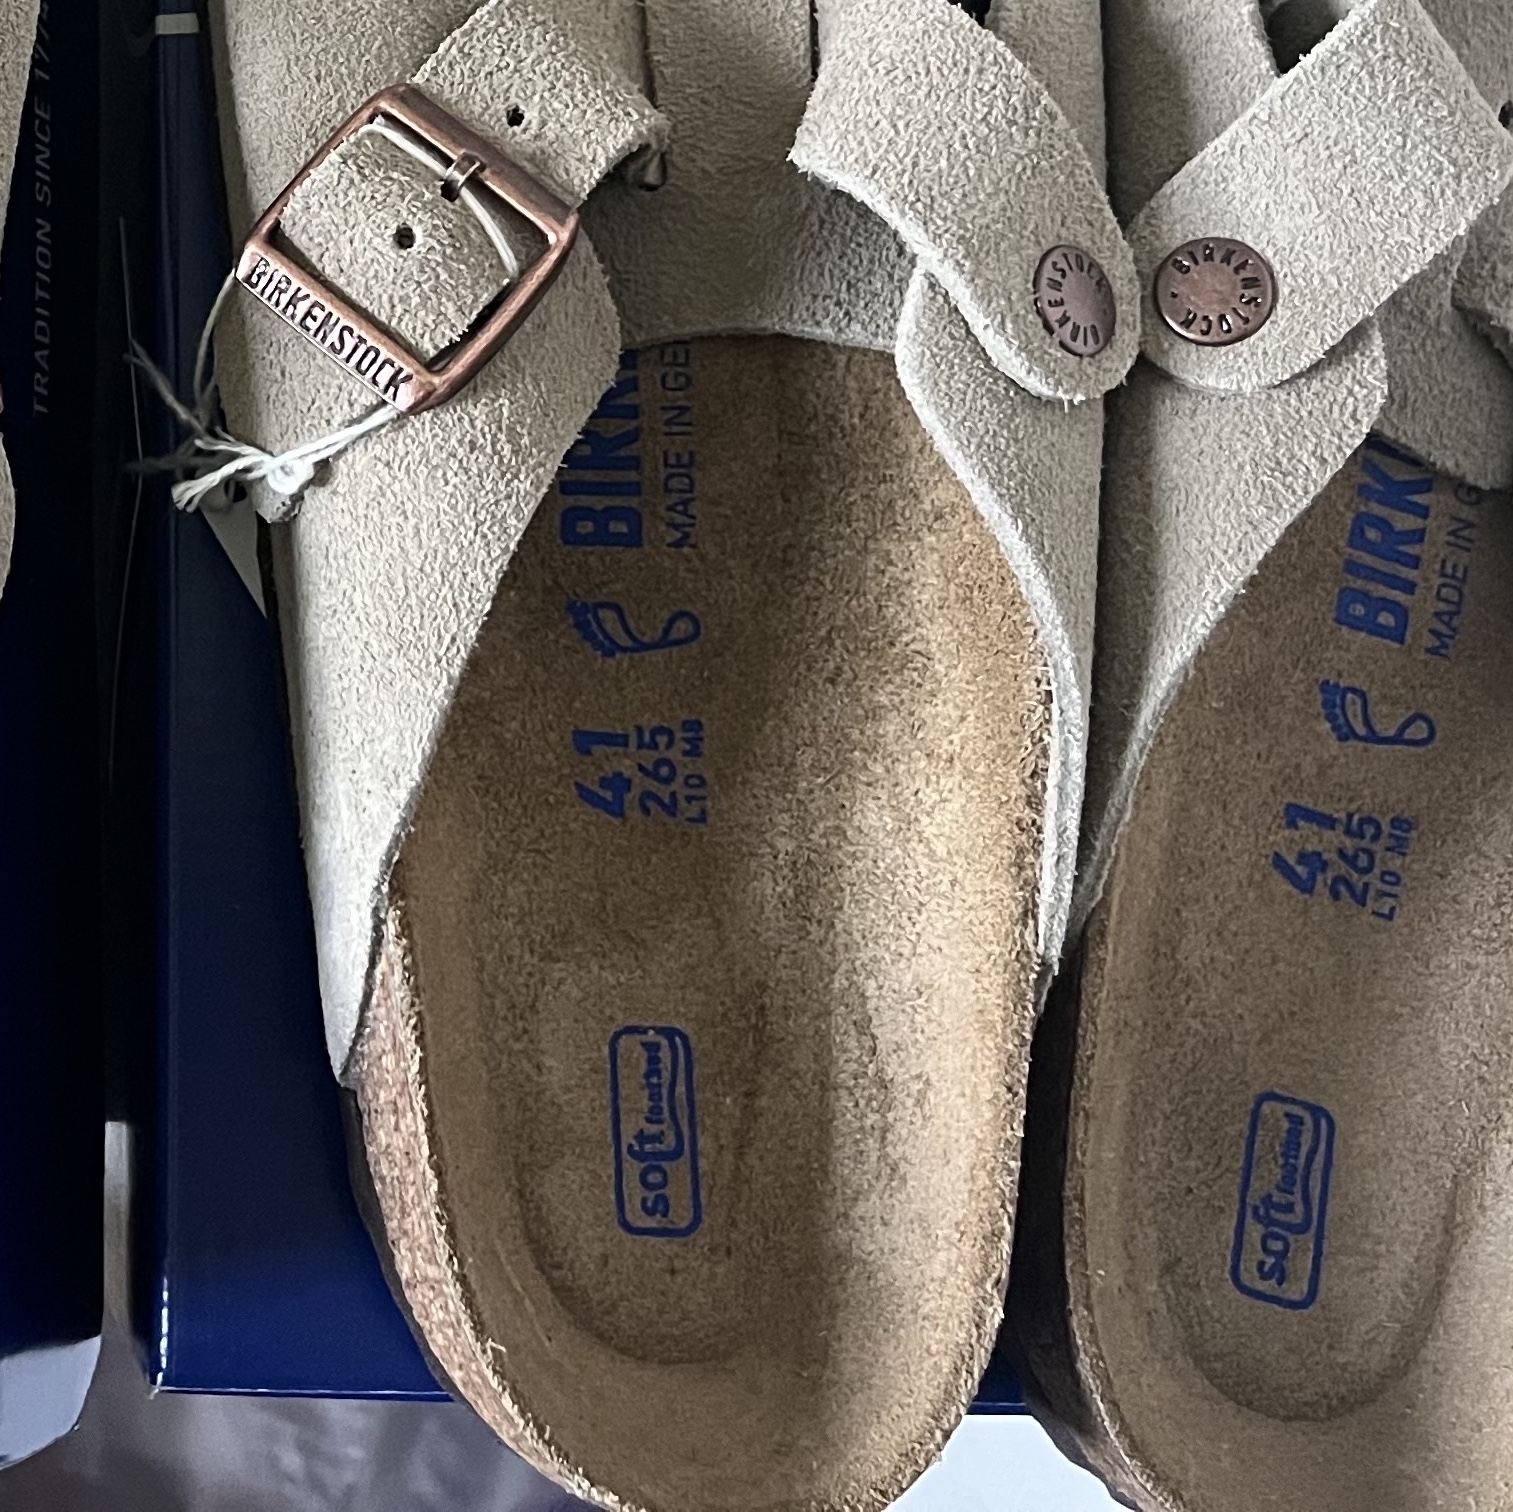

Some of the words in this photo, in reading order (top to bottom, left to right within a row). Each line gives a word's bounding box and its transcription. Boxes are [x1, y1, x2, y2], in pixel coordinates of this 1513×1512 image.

[33, 94, 53, 208] SINCE
[32, 216, 53, 417] TRADITION
[243, 255, 414, 403] BIRKENSTOCK
[1046, 252, 1106, 347] BIRKENSTOCK
[1171, 242, 1263, 337] BIRKENSTOCK
[660, 406, 692, 437] IN
[662, 449, 697, 549] MADE
[1444, 514, 1476, 553] IN
[1424, 558, 1469, 661] MADE
[573, 730, 633, 818] 41
[634, 725, 678, 818] 265
[682, 774, 708, 823] L10
[1272, 803, 1337, 896] 41
[1329, 812, 1382, 908] 265
[1371, 870, 1402, 922] L10
